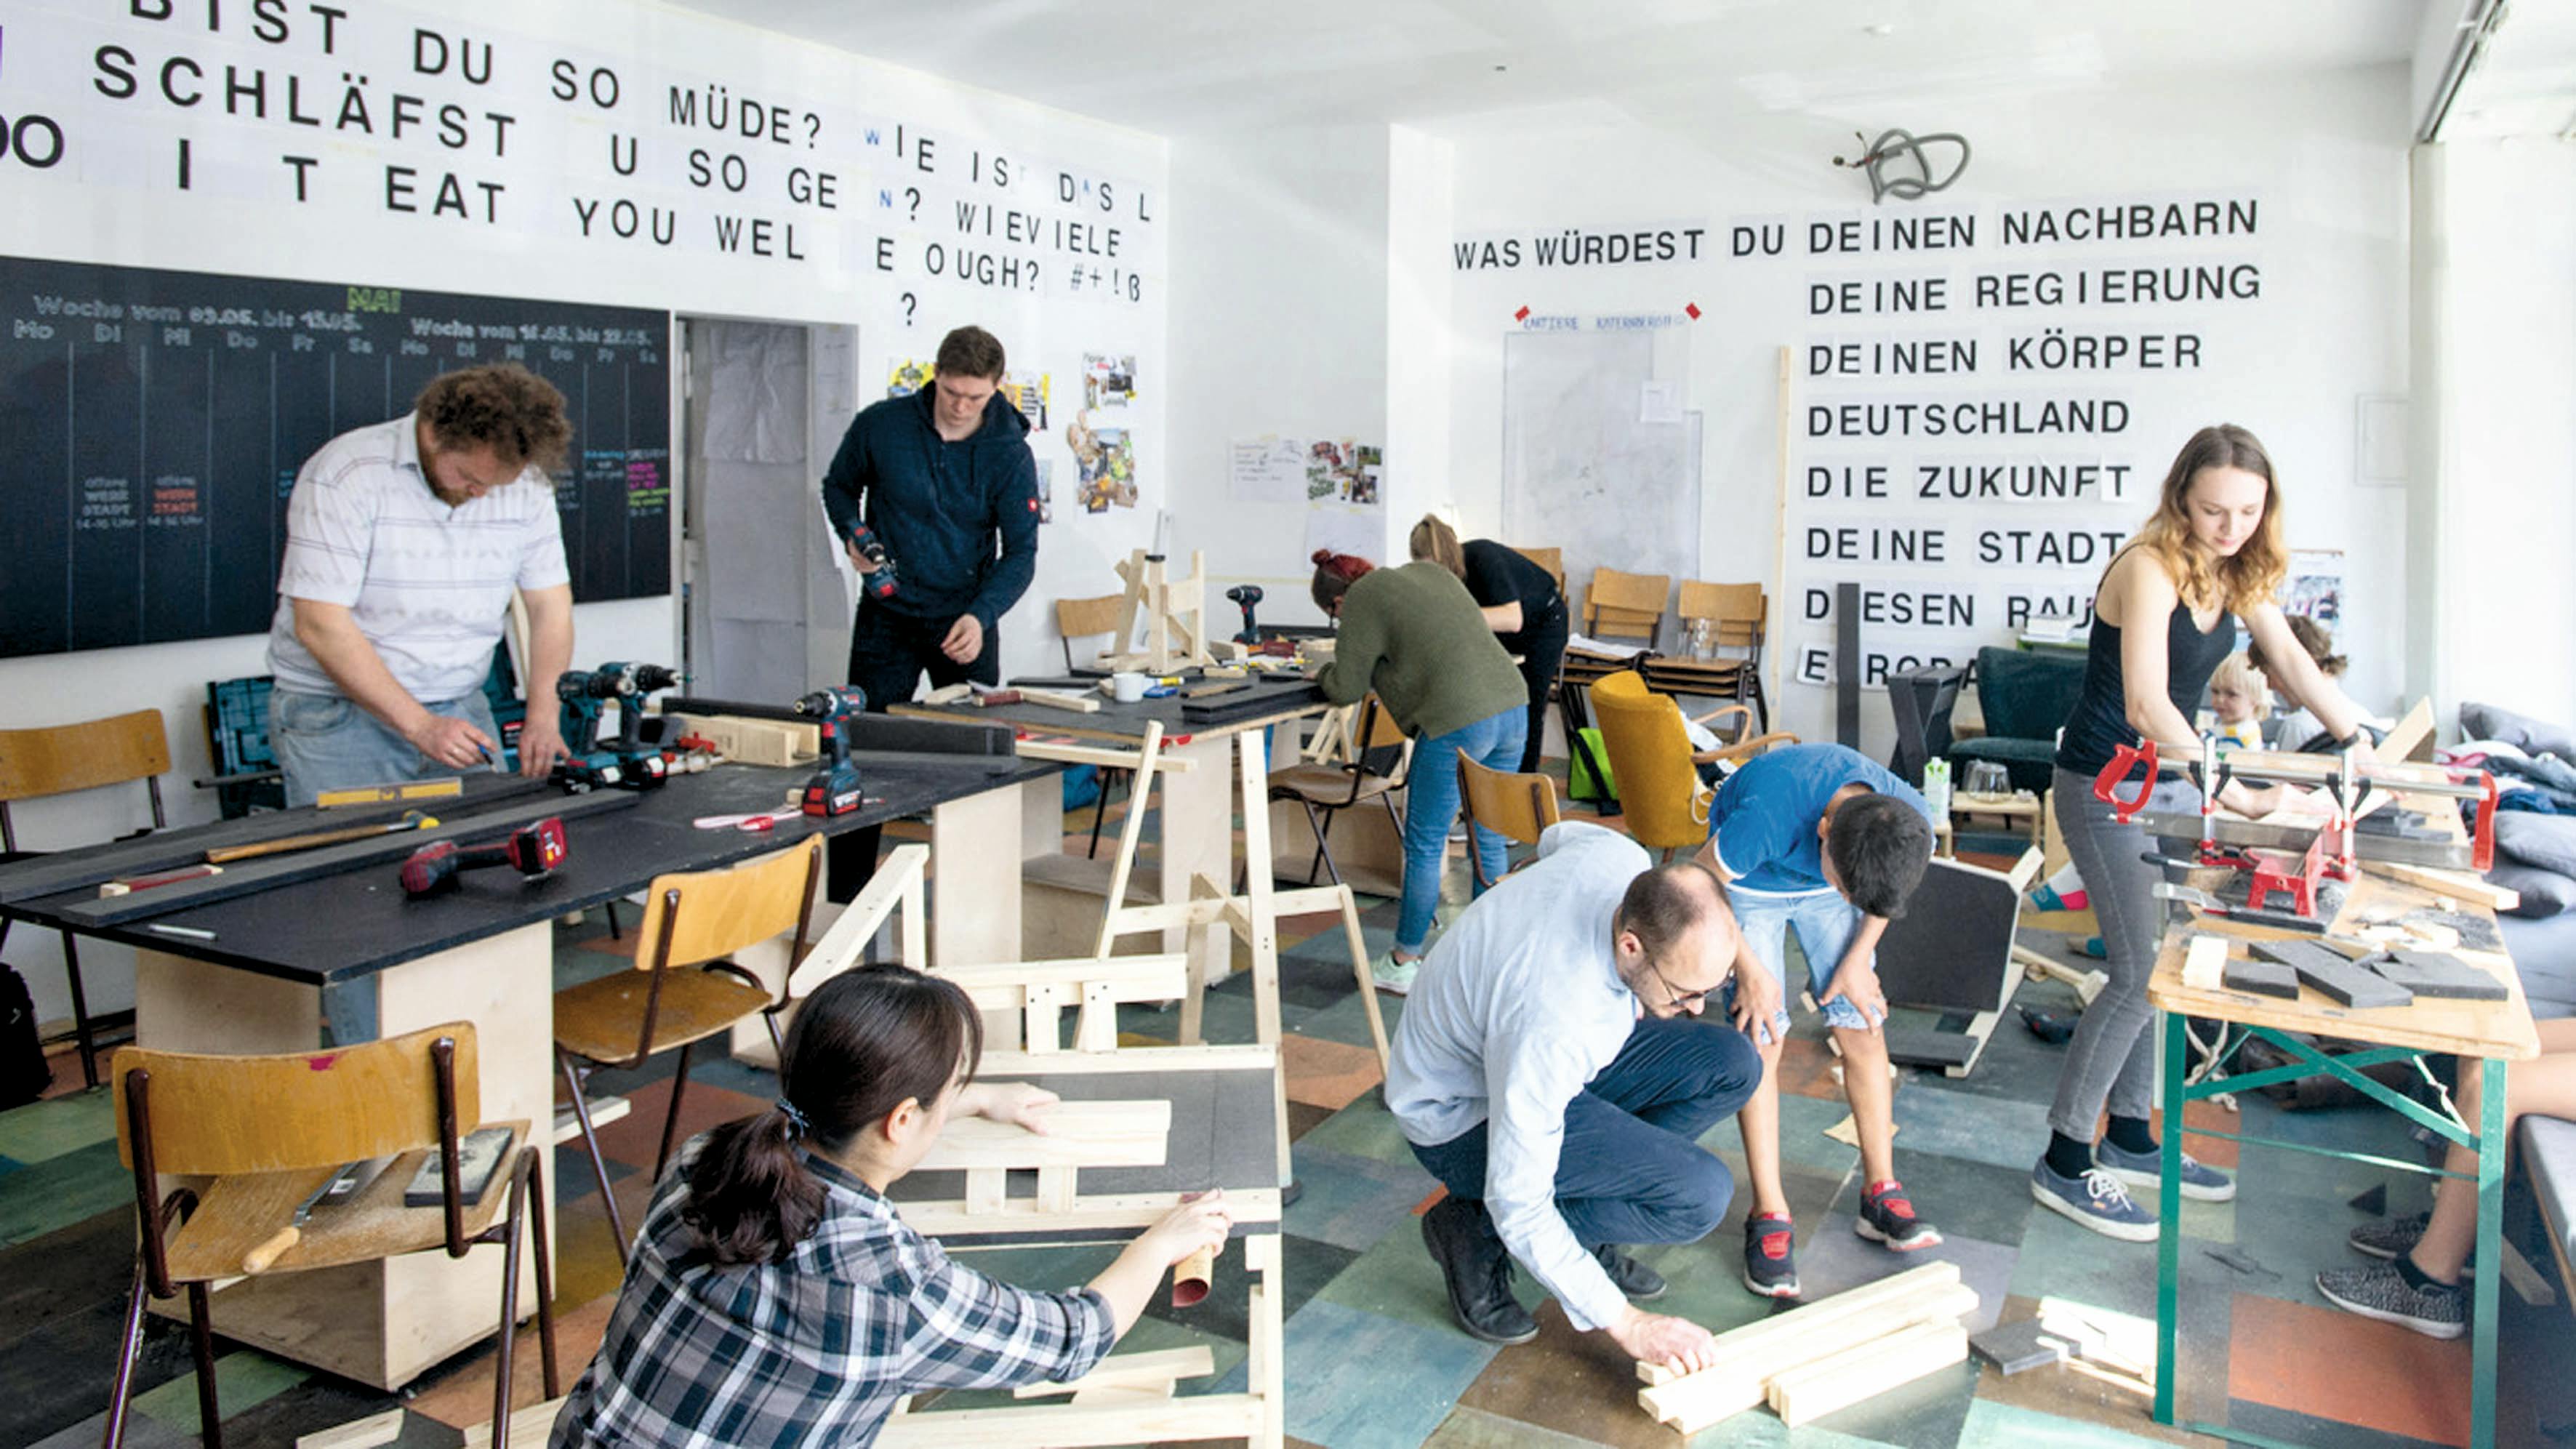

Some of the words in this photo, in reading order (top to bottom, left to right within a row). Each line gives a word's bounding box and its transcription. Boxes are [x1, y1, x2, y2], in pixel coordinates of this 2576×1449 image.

[93, 44, 515, 157] SCHLÄFST
[611, 133, 638, 177] U
[689, 148, 747, 193] SO
[787, 167, 838, 209] GE
[414, 28, 493, 86] DU
[551, 59, 620, 109] SO
[670, 84, 821, 148] MÜDE?
[1139, 193, 1151, 222] L
[0, 113, 65, 169] O
[178, 138, 191, 191] I
[282, 155, 319, 202] T
[385, 164, 506, 225] EAT
[573, 198, 676, 246] YOU
[715, 215, 806, 261] WEL
[926, 243, 1040, 292] OUGH?
[1454, 240, 1521, 269] WAS
[1535, 229, 1705, 266] WÜRDEST
[1733, 225, 1785, 257] DU
[1810, 215, 1975, 254] DEINEN
[2004, 199, 2258, 245] NACHBARN
[33, 294, 123, 320] Woche
[131, 303, 181, 322] vom
[1810, 278, 1947, 315] DEINE
[1977, 264, 2260, 308] REGIERUNG
[14, 318, 55, 340] Mo
[411, 317, 474, 340] Woche
[1810, 340, 1977, 376] DEINEN
[2010, 329, 2202, 370] KÖRPER
[1808, 400, 2130, 437] DEUTSCHLAND
[1807, 467, 1888, 498] DIE
[1919, 465, 2132, 499] ZUKUNFT
[1807, 527, 1946, 562] DEINE
[1979, 531, 2126, 564] STADT
[1805, 588, 1974, 627] DESEN
